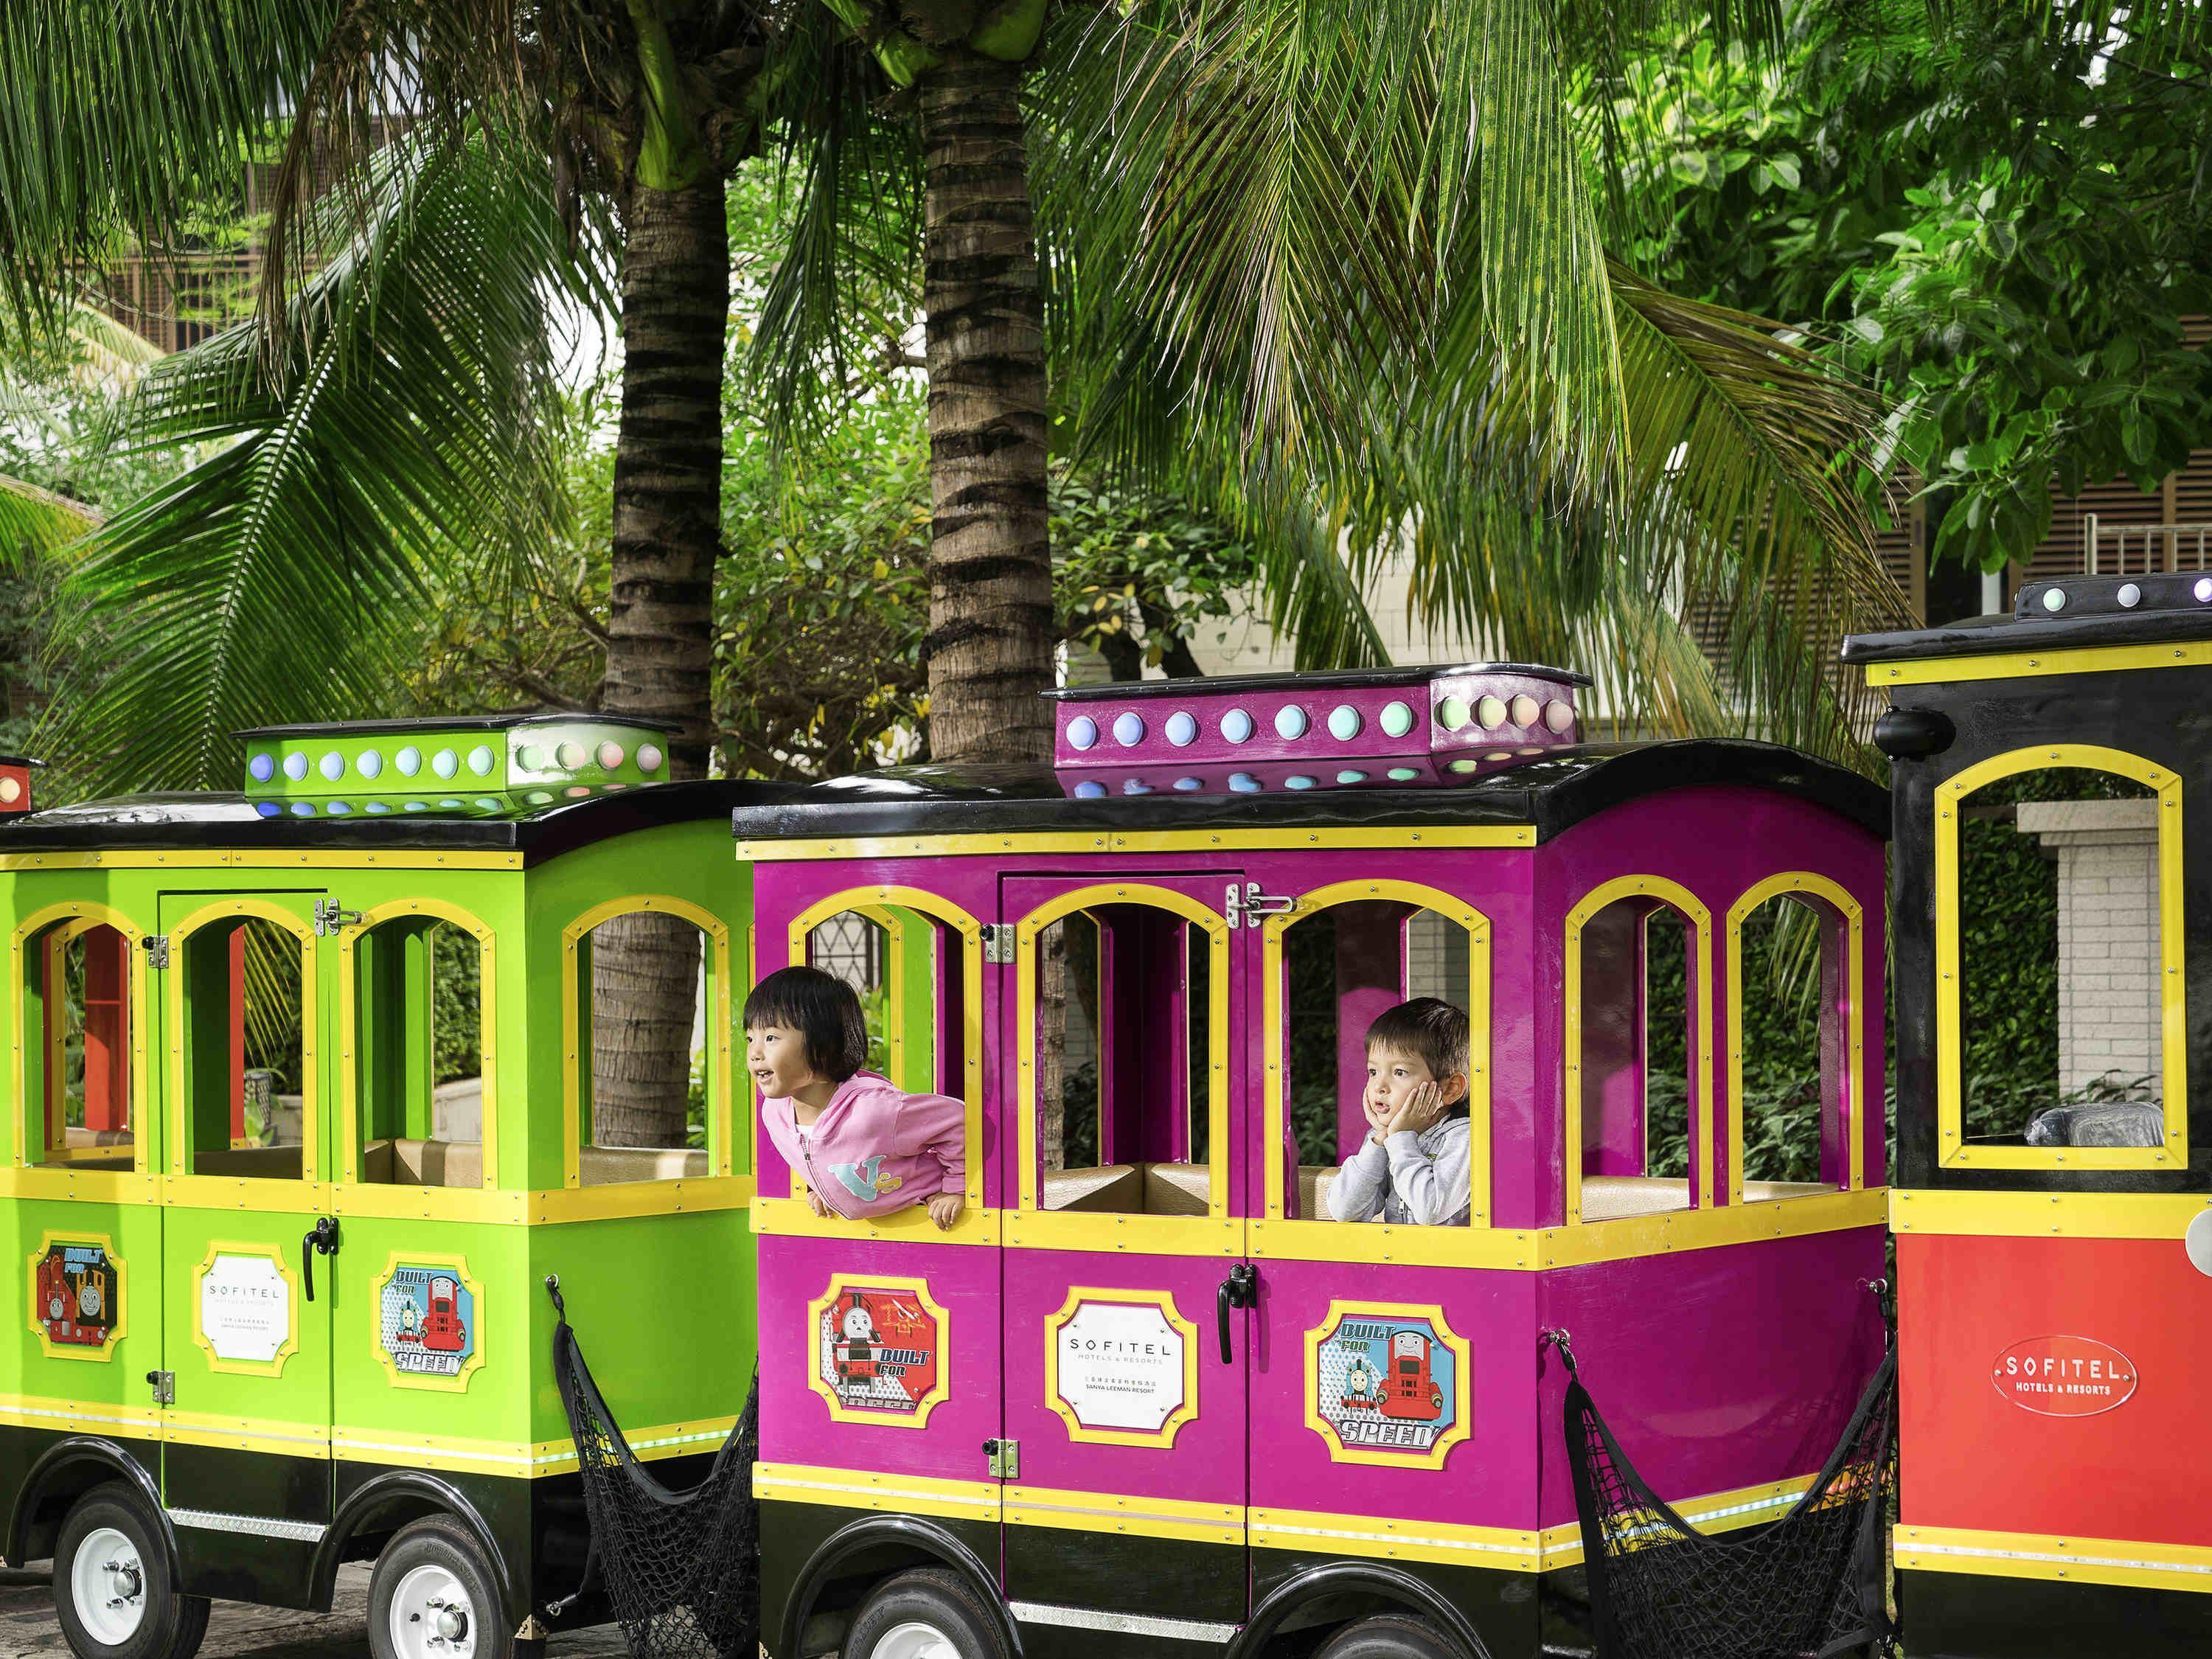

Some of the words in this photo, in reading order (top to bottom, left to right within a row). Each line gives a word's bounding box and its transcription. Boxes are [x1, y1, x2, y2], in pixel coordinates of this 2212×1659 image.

[64, 1248, 103, 1263] BUILT
[64, 1263, 85, 1273] FOR
[395, 1270, 433, 1284] BUILT
[209, 1285, 279, 1298] SOFITEL
[395, 1284, 416, 1295] FOR
[1340, 1324, 1396, 1340] BUILT
[1069, 1338, 1172, 1356] SOFITEL
[1340, 1340, 1369, 1352] FOR
[394, 1352, 460, 1374] SPEED
[879, 1349, 930, 1366] BUILT
[879, 1365, 907, 1377] FOR
[2006, 1356, 2120, 1380] SOFITEL
[2015, 1381, 2054, 1393] HOTELS
[2057, 1385, 2064, 1394] &
[2067, 1384, 2111, 1396] RESORTS
[1340, 1419, 1435, 1448] SPEED
